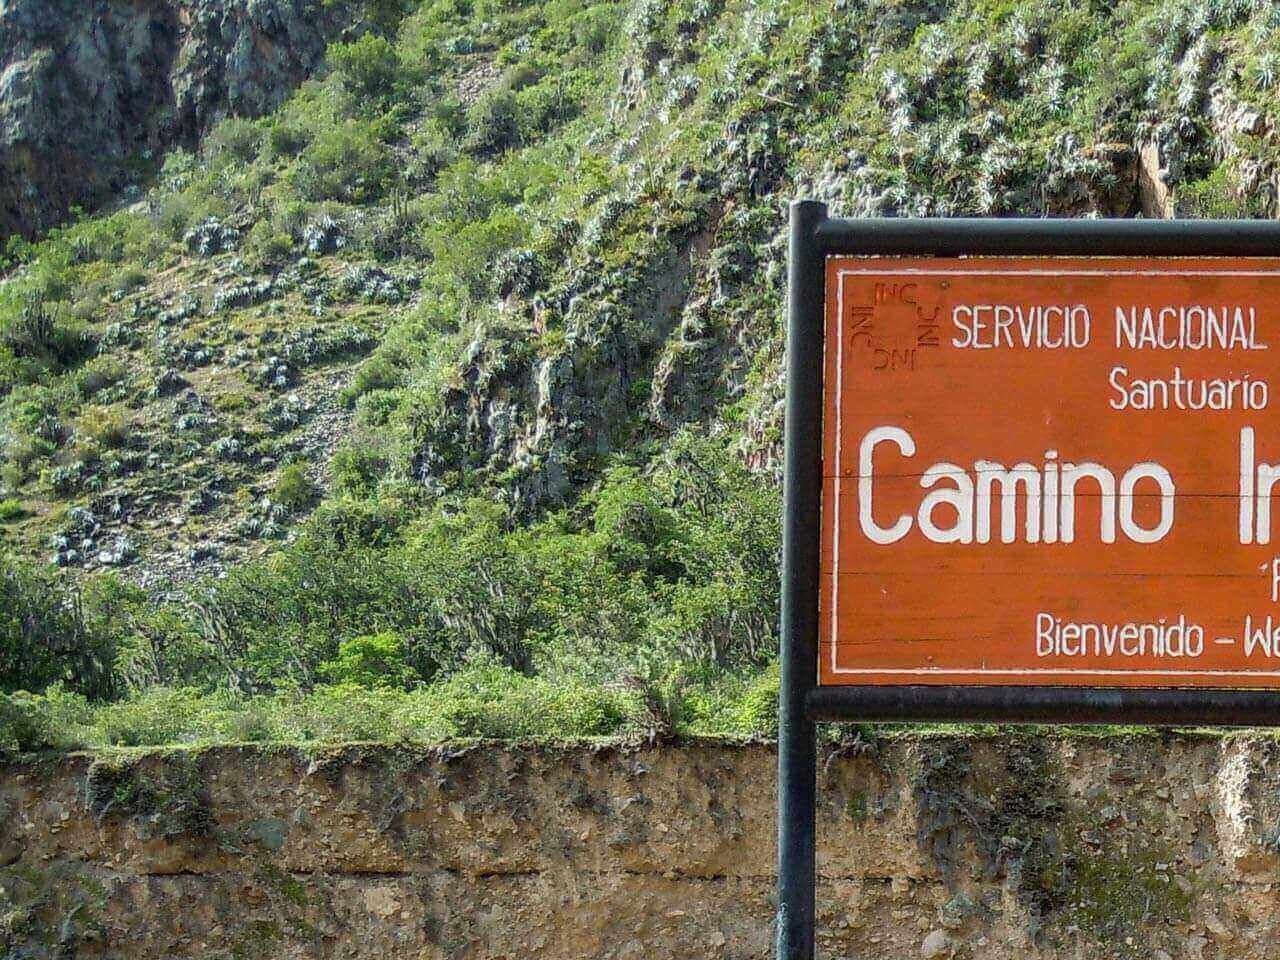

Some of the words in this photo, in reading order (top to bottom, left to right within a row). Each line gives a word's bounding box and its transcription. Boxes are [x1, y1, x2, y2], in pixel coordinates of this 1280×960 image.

[951, 303, 1091, 349] SERVICIO
[1115, 305, 1268, 350] NACIONAL
[1109, 366, 1268, 410] Santuario
[858, 425, 1176, 545] Camino
[1035, 612, 1204, 658] Bienvenido
